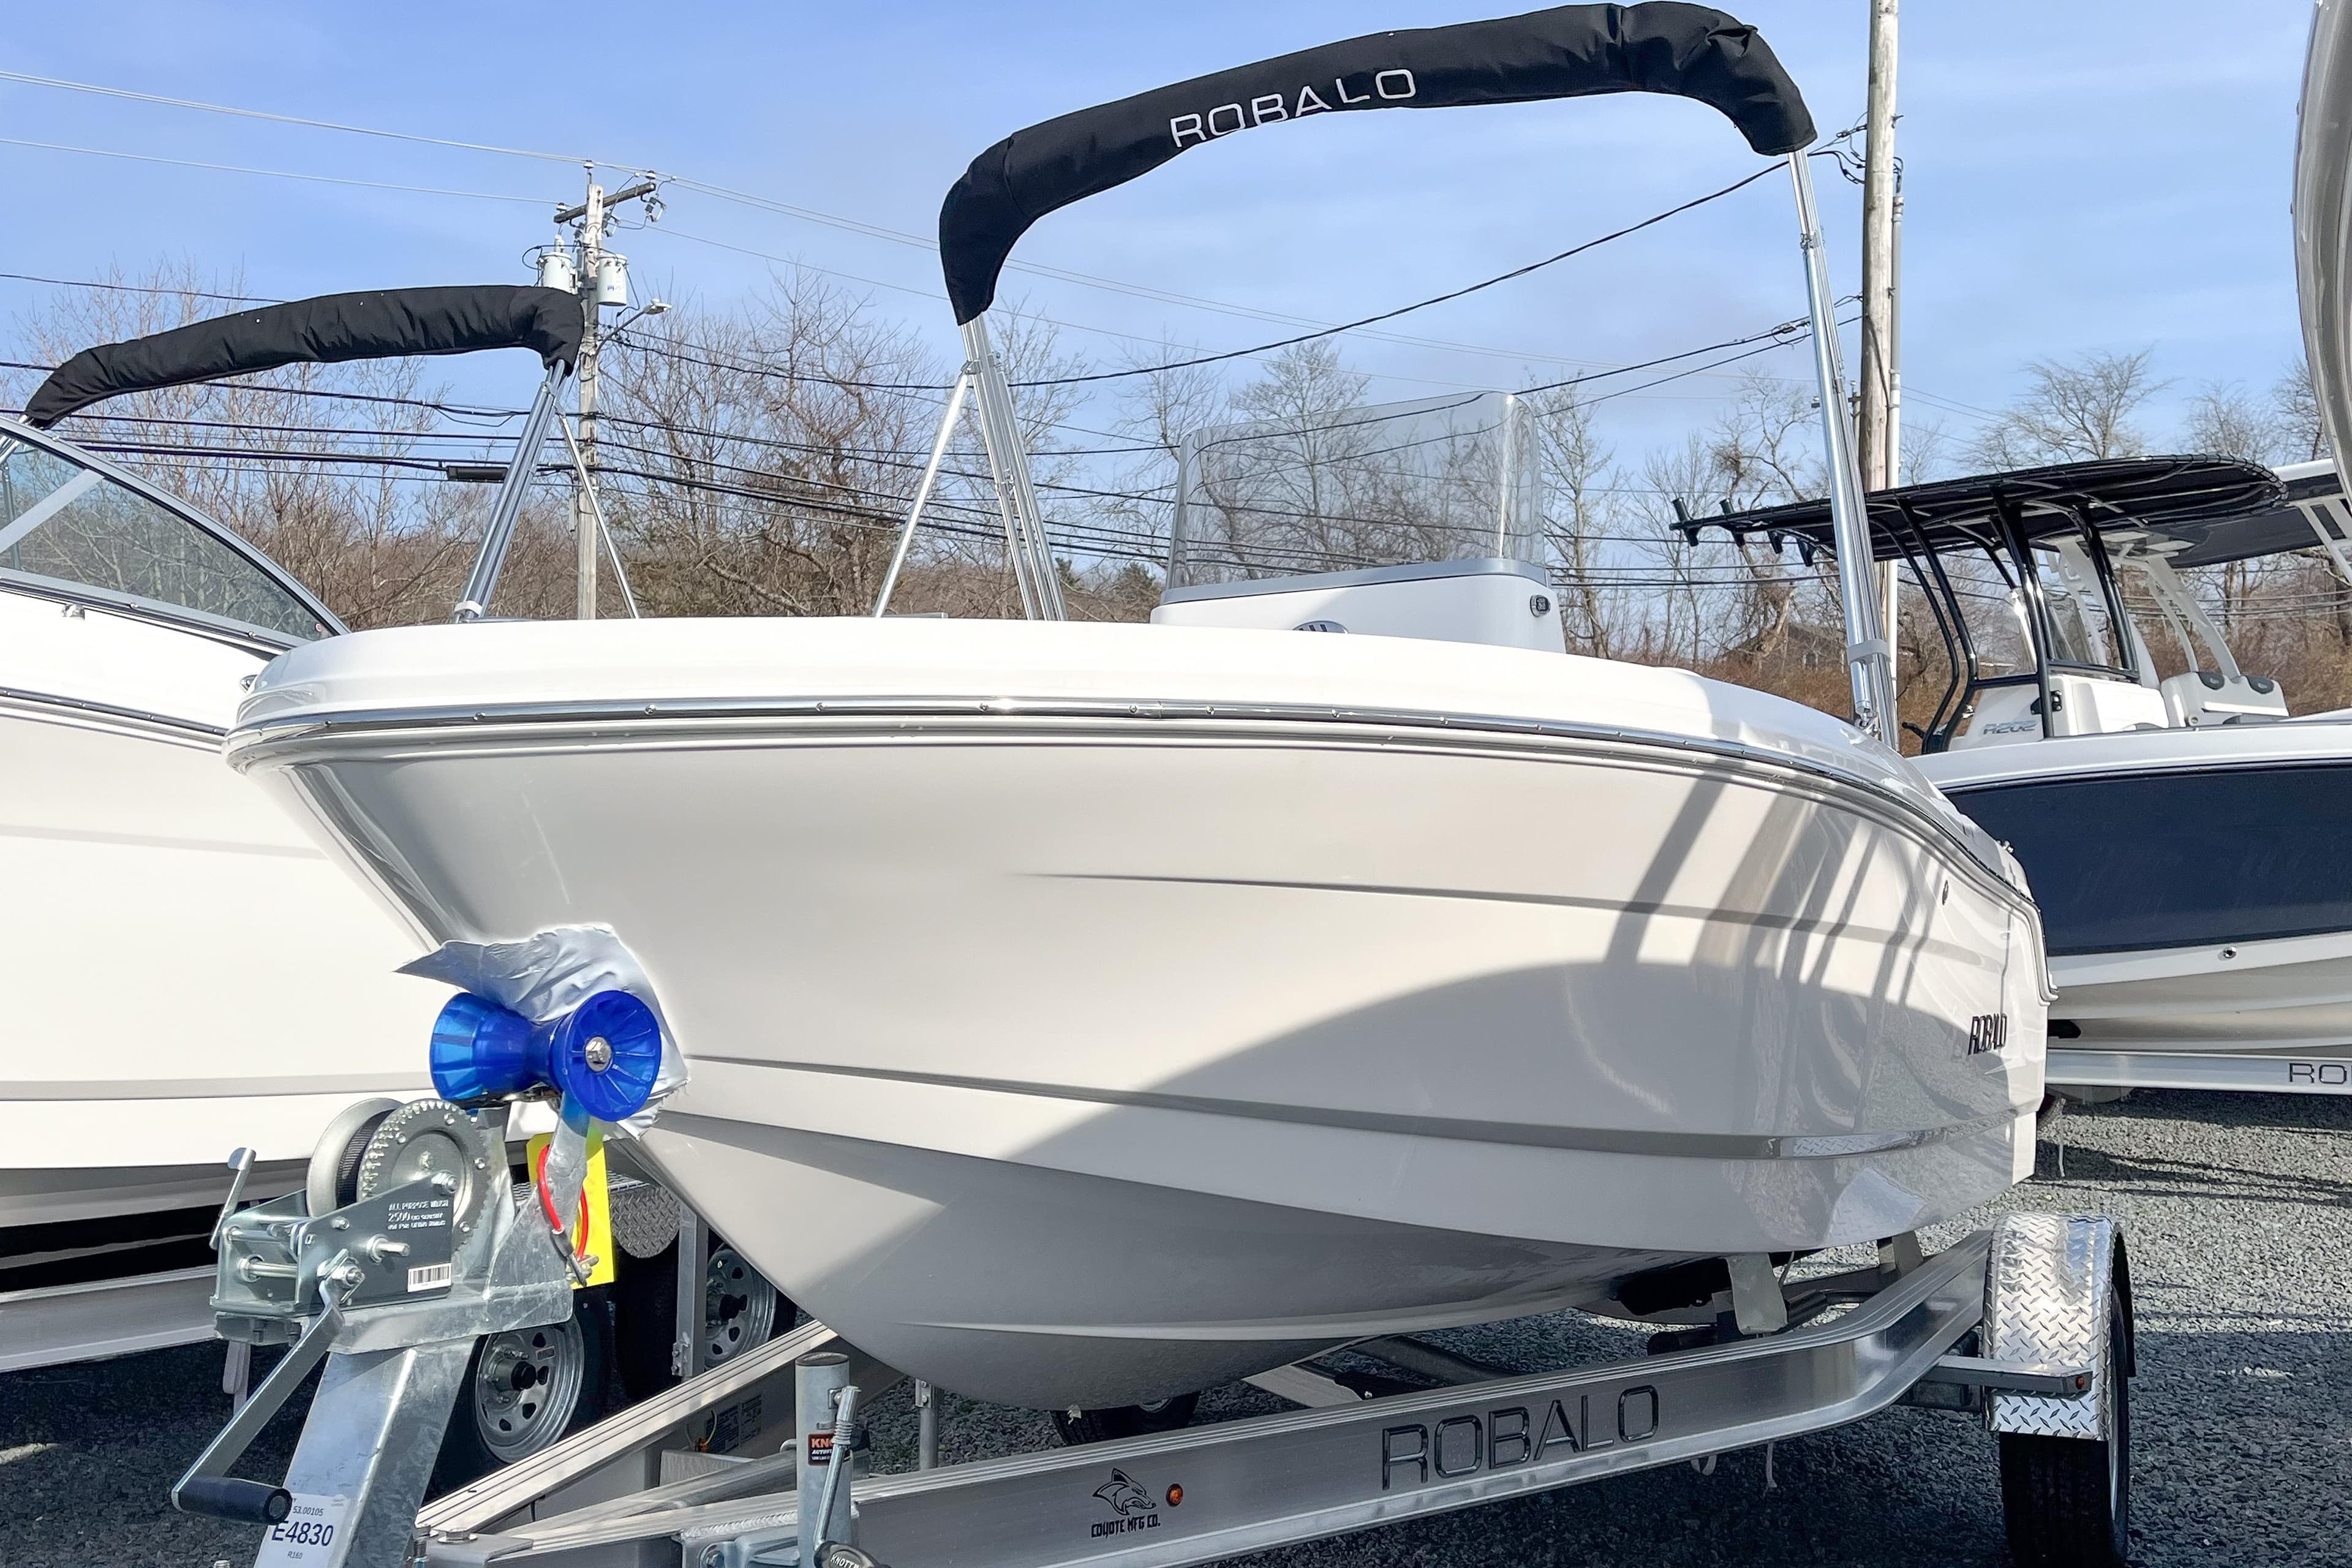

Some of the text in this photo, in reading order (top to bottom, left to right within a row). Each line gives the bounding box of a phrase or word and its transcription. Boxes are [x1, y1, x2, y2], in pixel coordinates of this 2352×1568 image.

[1170, 69, 1415, 148] ROBALO
[2289, 1063, 2352, 1084] RO
[1382, 1385, 1659, 1490] ROBALO
[271, 1520, 334, 1547] E4830
[1091, 1513, 1161, 1539] COYOTE MFG CO.
